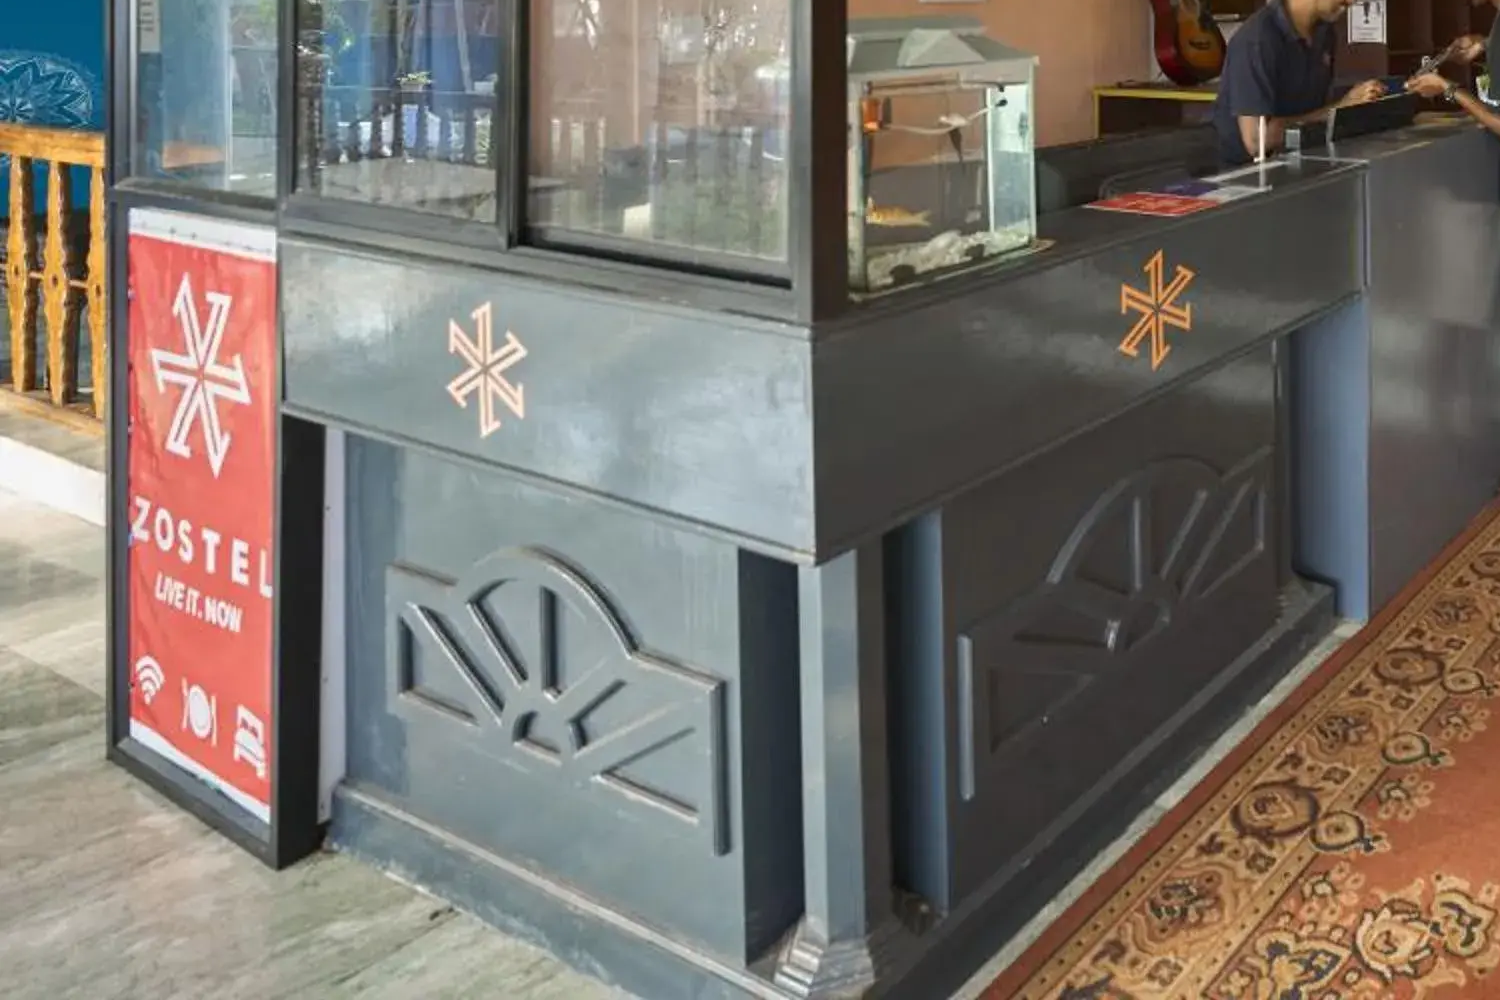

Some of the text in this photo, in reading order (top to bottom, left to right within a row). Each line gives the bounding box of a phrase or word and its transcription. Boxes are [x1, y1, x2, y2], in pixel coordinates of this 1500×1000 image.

[131, 495, 273, 598] ZOSTEL
[155, 571, 185, 611] LIVE
[204, 596, 243, 633] NOW
